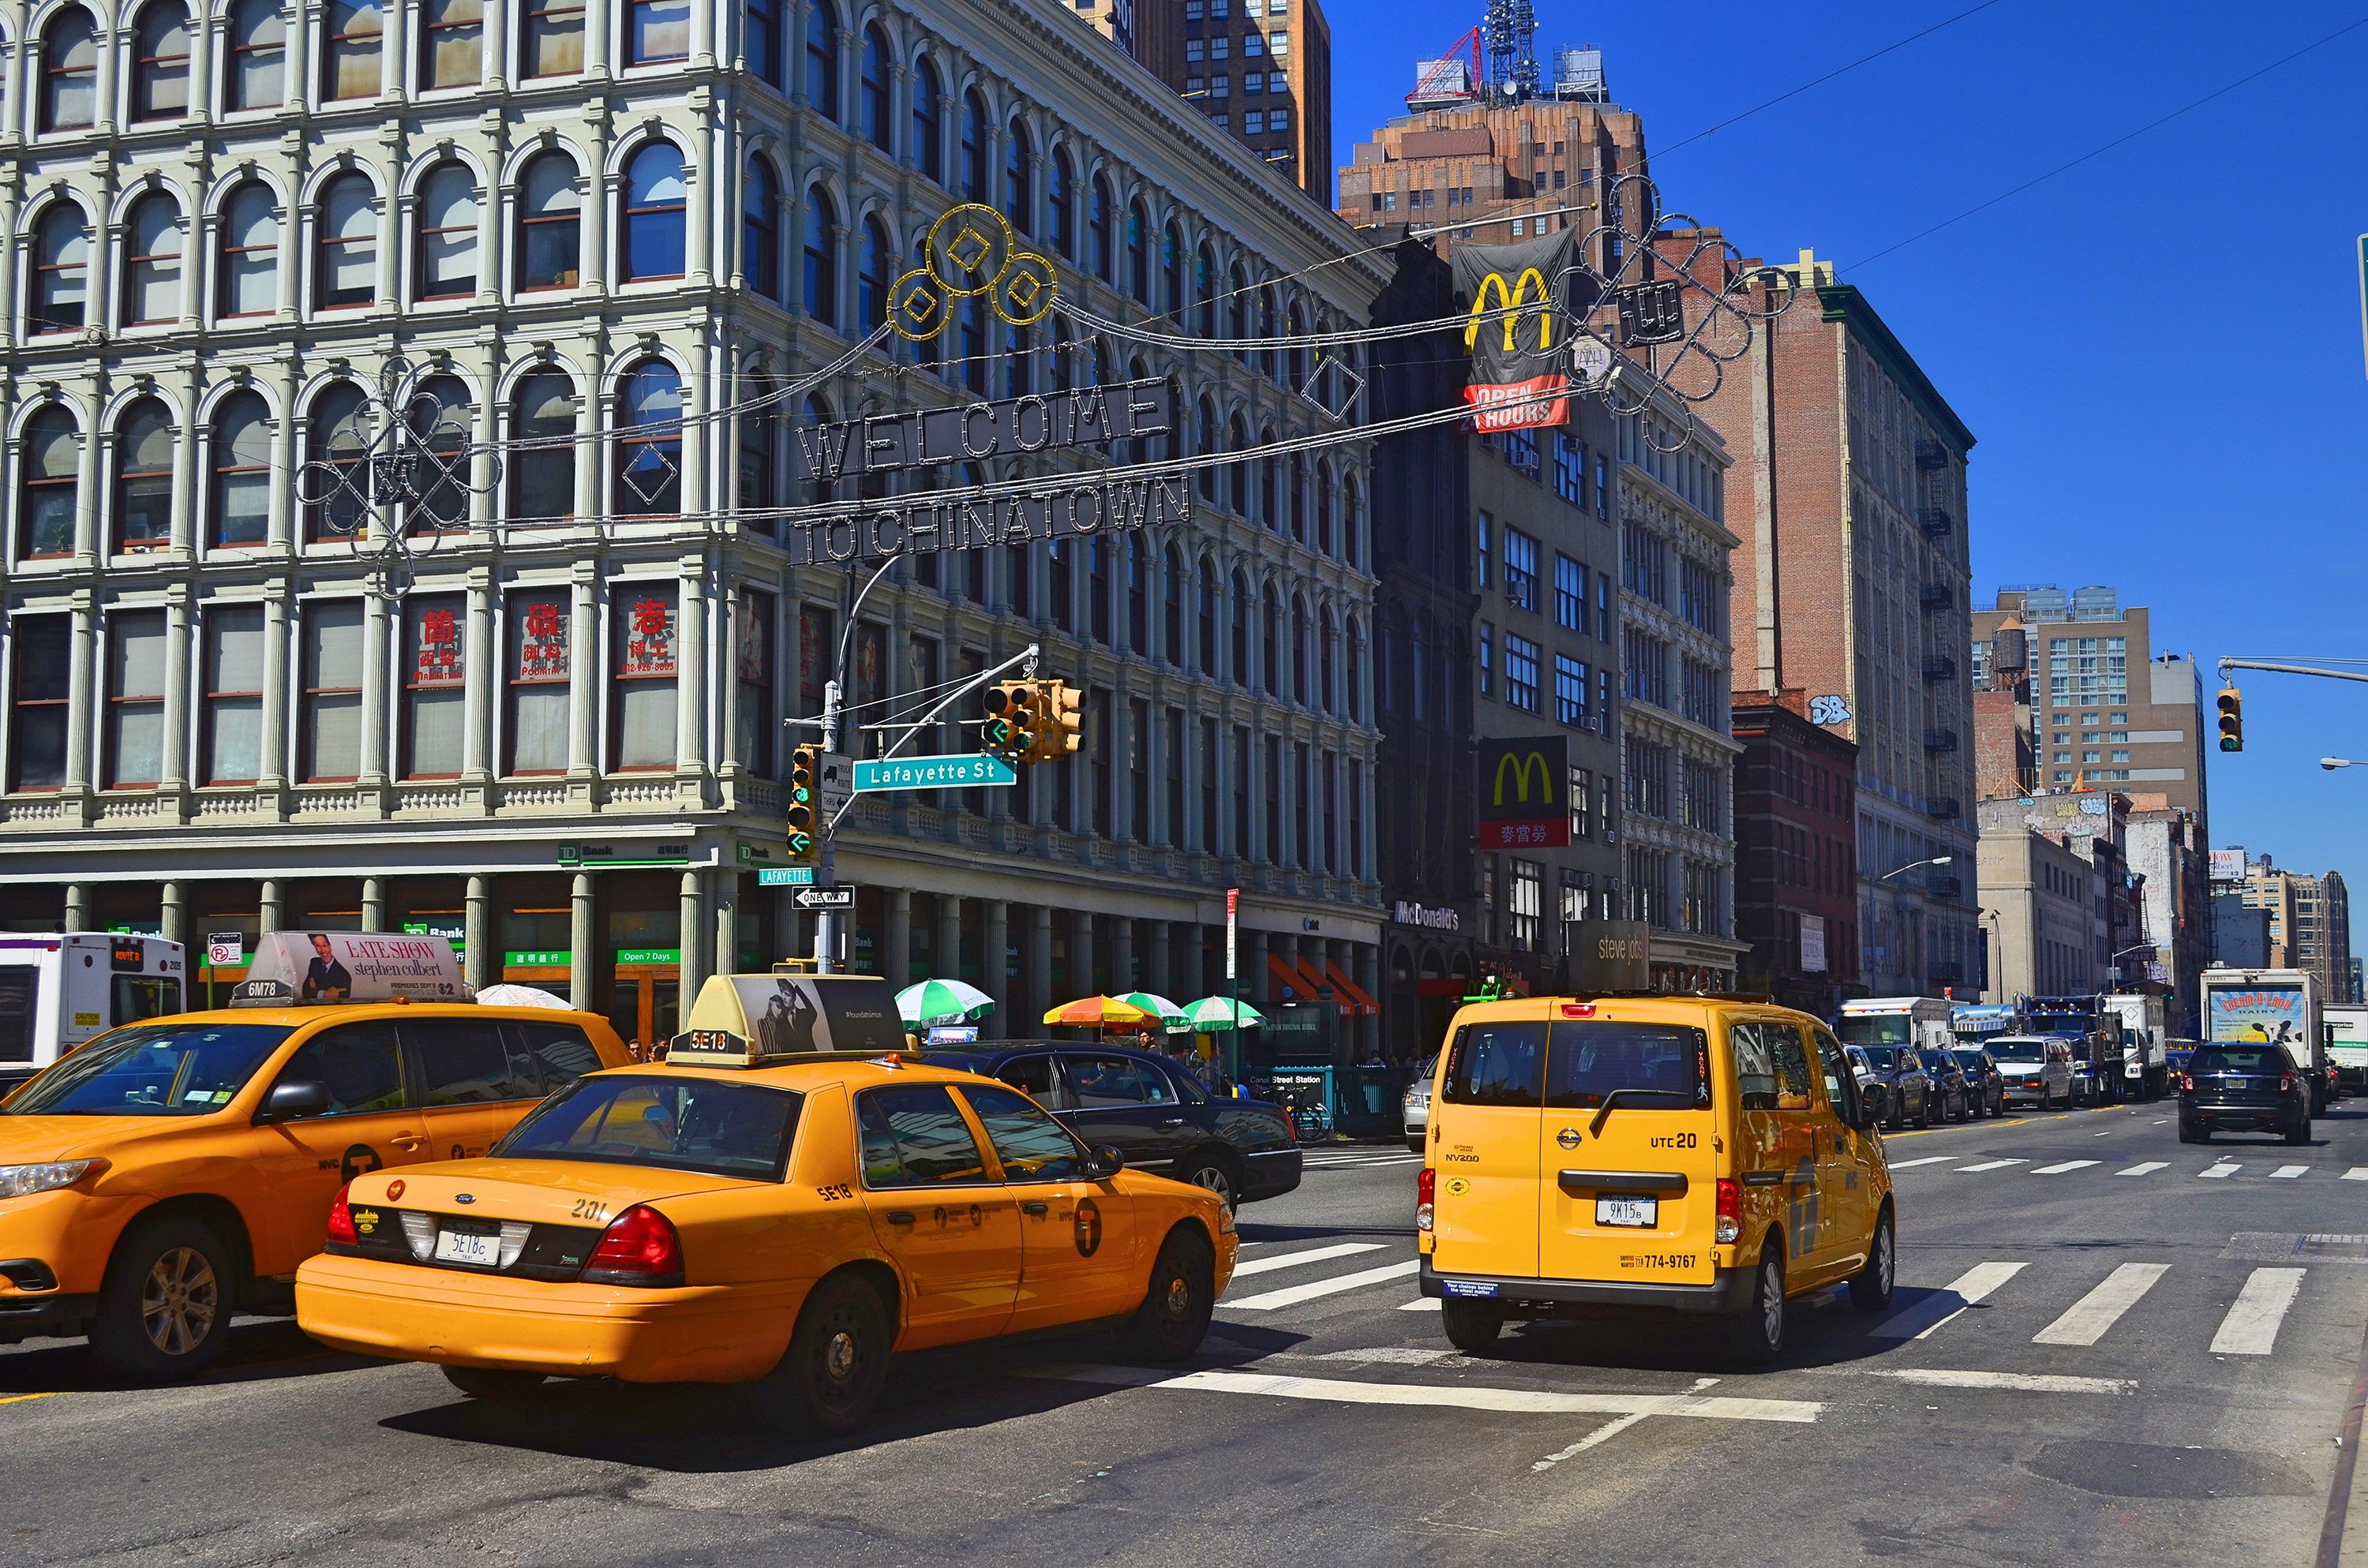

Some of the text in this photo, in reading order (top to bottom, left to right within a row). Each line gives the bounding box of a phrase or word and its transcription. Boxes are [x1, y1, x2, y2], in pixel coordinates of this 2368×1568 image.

[1478, 384, 1532, 408] OPEN
[1486, 401, 1550, 428] HOURS
[796, 377, 1171, 479] WELCOME
[793, 475, 1191, 566] TO CHINATOWN
[632, 598, 666, 634] 志
[628, 639, 668, 658] 博士
[838, 764, 851, 773] TRUCK
[871, 761, 995, 784] Lafayette St
[838, 779, 851, 788] ROUTE
[824, 796, 837, 806] THRU
[1501, 825, 1546, 843] 麥當勞
[560, 846, 613, 859] TD Bank
[761, 870, 807, 883] LAFAYETTE
[1395, 900, 1459, 930] McDonald's
[344, 940, 389, 958] LATE
[390, 941, 435, 959] SHOW
[856, 937, 872, 947] Bank
[1598, 934, 1643, 966] steve jobs
[116, 950, 133, 960] ROUTE
[516, 953, 559, 963] 道明銀行
[624, 952, 645, 962] Open
[652, 952, 671, 962] Days
[170, 961, 182, 971] 2109
[354, 959, 442, 982] stephen colbert
[249, 982, 276, 996] 6M78
[691, 1032, 726, 1050] 5E18
[1448, 1048, 1458, 1074] VACANT
[1650, 1133, 1696, 1148] UTC 20
[319, 1159, 339, 1169] NYC
[817, 1184, 853, 1201] 5E18
[571, 1199, 607, 1222] 201
[1058, 1211, 1073, 1222] NYC
[1610, 1203, 1642, 1219] 9K15B
[1644, 1255, 1696, 1268] 774-9767
